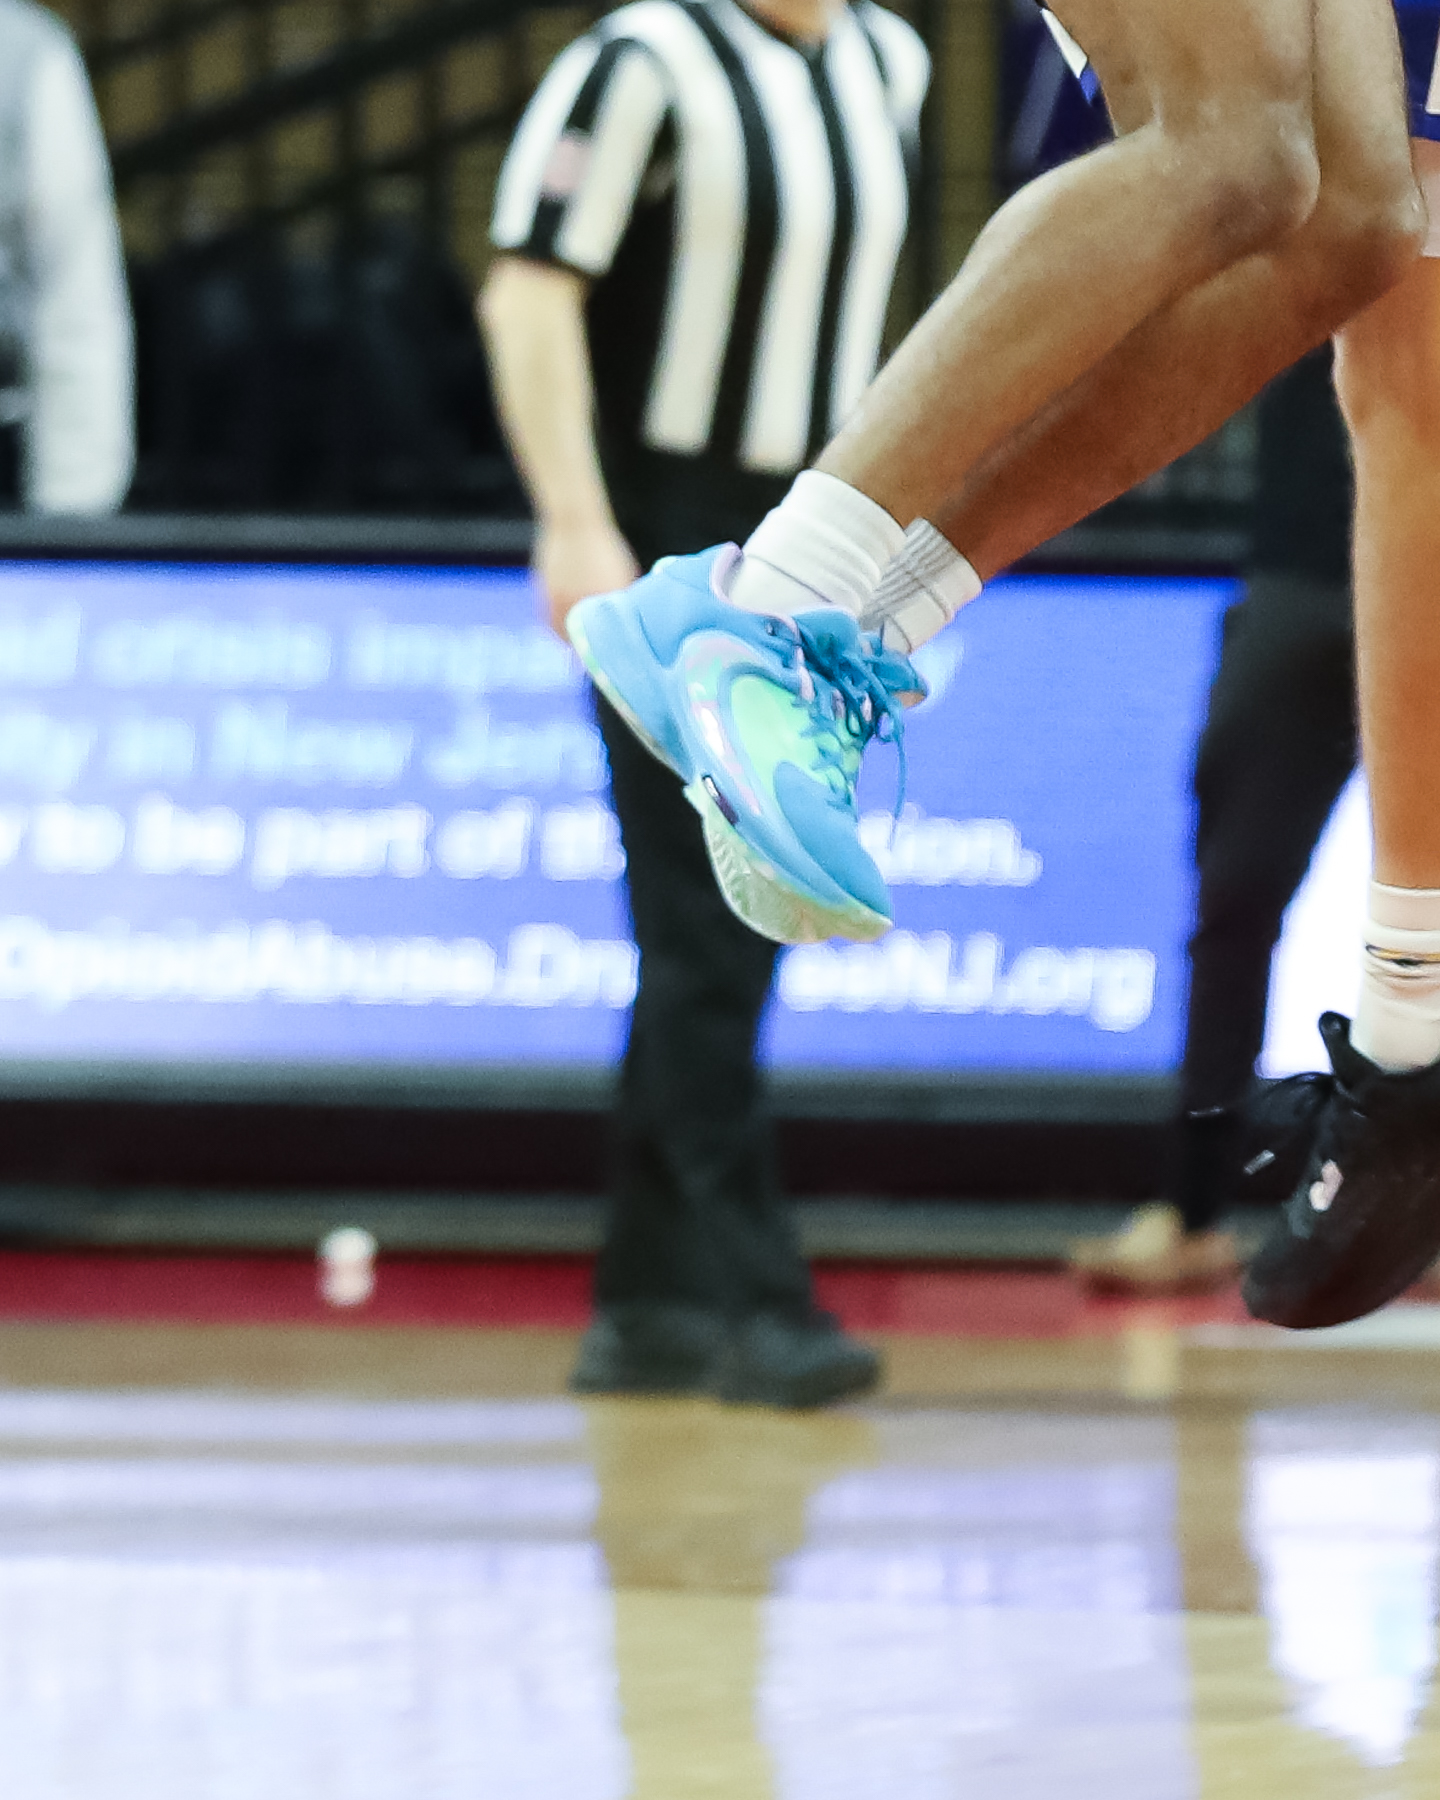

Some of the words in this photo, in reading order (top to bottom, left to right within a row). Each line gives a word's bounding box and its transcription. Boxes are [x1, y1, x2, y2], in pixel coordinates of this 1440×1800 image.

[345, 608, 574, 702] impa
[210, 698, 413, 783] New
[424, 702, 600, 790] Jer
[33, 800, 125, 874] to
[133, 794, 245, 876] be
[252, 803, 430, 890] part
[435, 797, 534, 880] of
